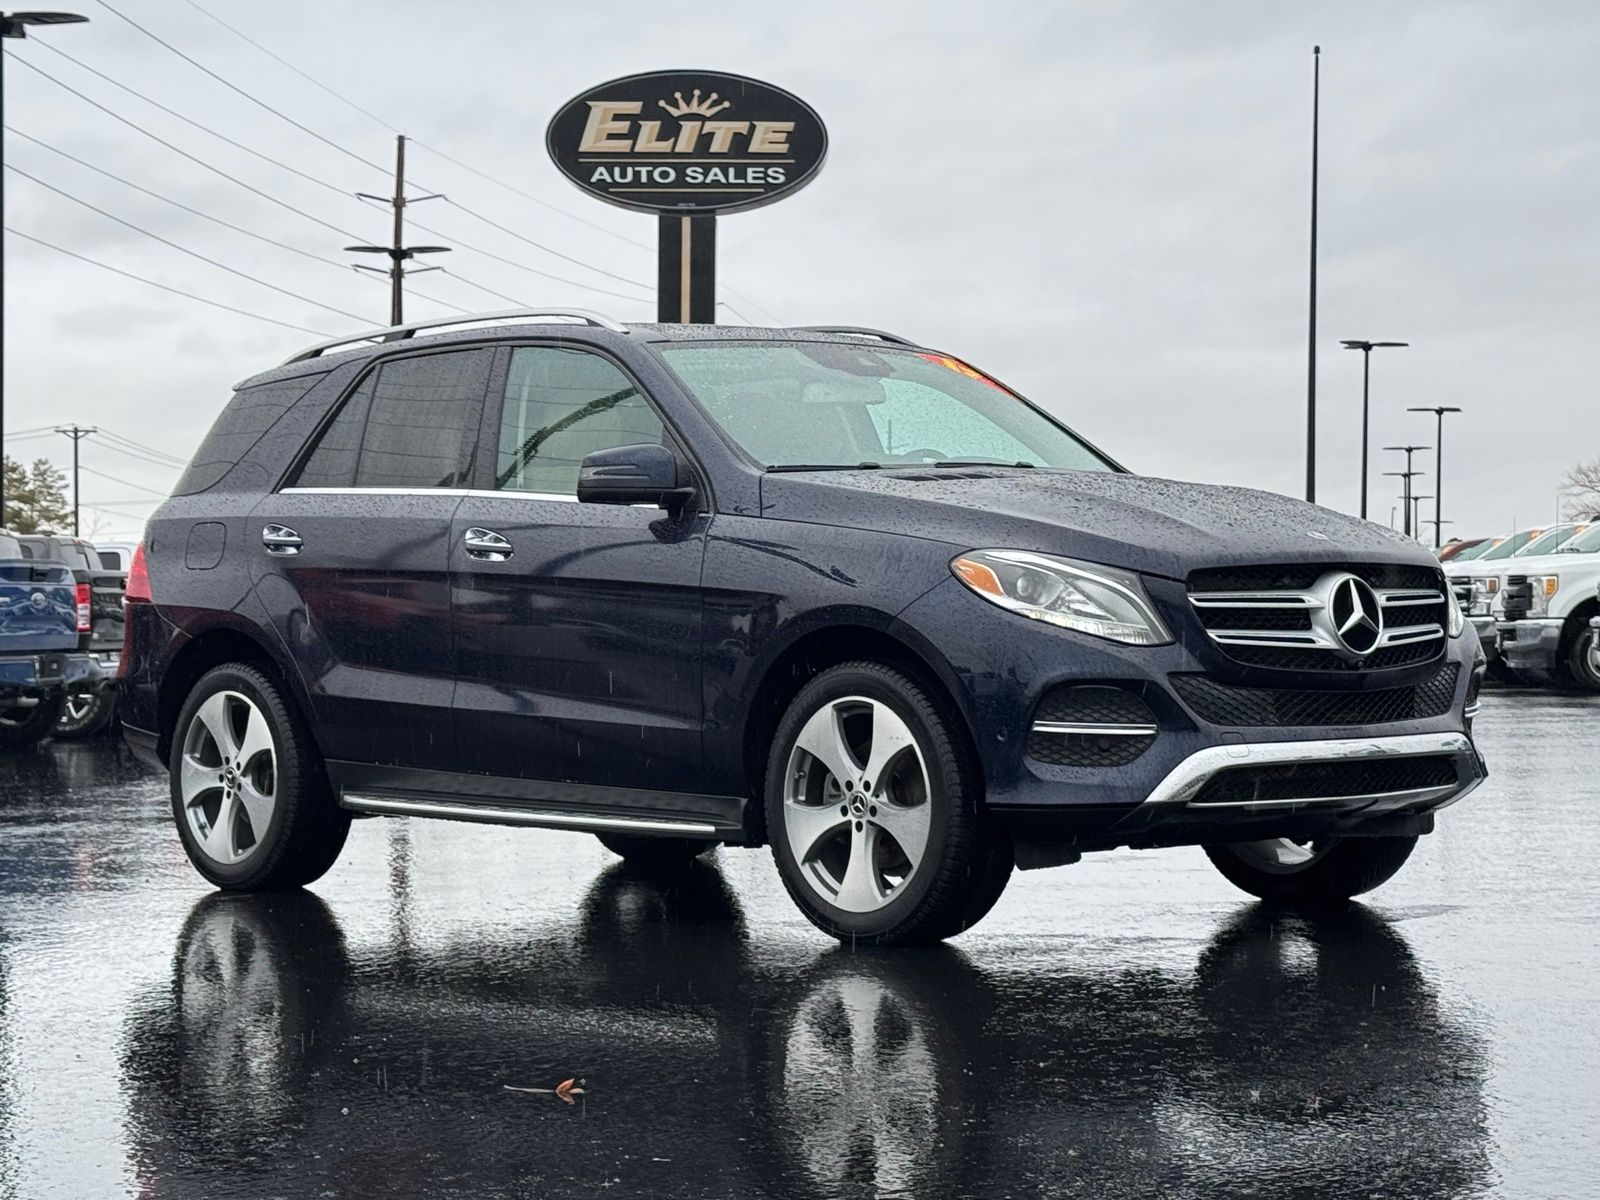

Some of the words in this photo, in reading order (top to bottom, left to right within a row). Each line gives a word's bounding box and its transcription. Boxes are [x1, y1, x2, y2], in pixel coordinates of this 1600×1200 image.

[578, 101, 795, 153] ELITE
[590, 166, 677, 184] AUTO
[685, 166, 786, 184] SALES
